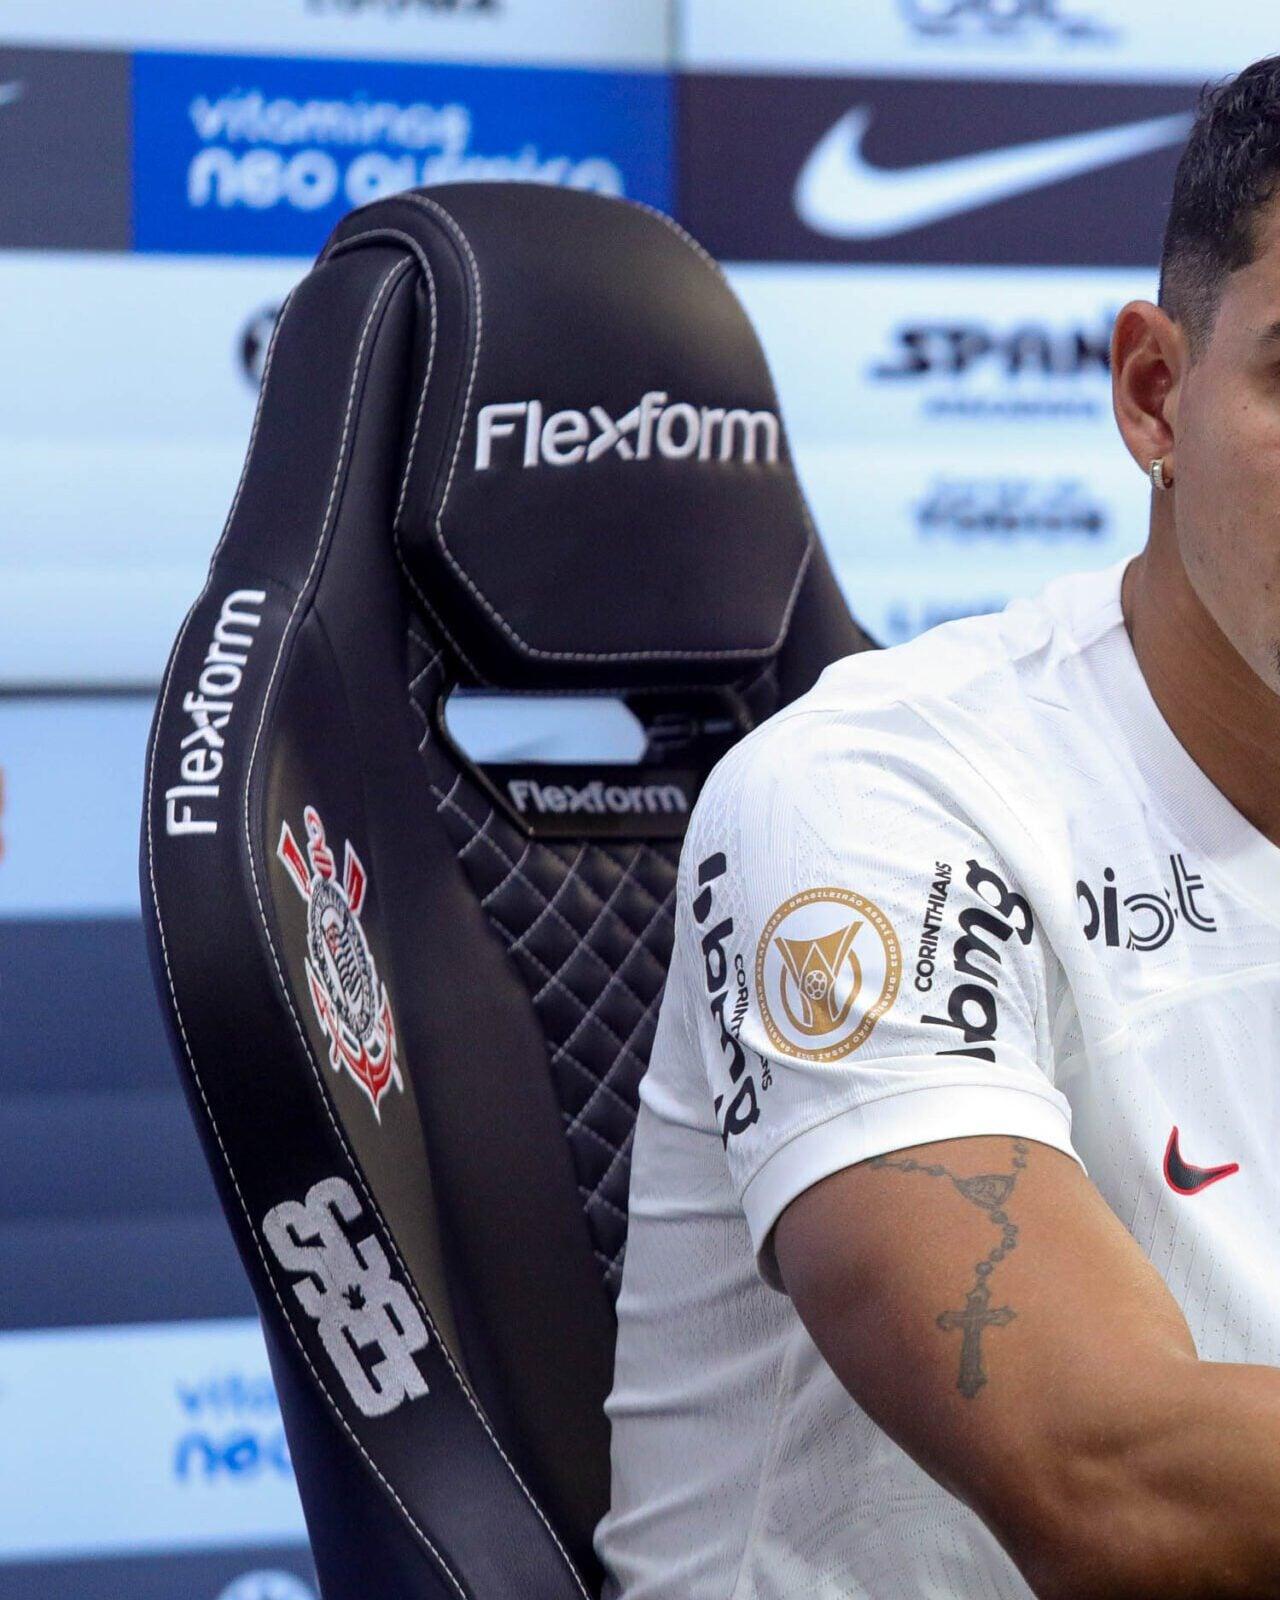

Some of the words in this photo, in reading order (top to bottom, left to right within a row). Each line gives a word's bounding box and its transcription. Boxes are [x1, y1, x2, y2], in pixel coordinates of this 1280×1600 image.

[188, 148, 338, 208] neo
[476, 391, 778, 471] Flexform
[166, 589, 266, 836] Flexform
[508, 780, 687, 813] Flexform
[915, 861, 952, 992] CORINTHIANS
[920, 859, 1034, 1043] bmg
